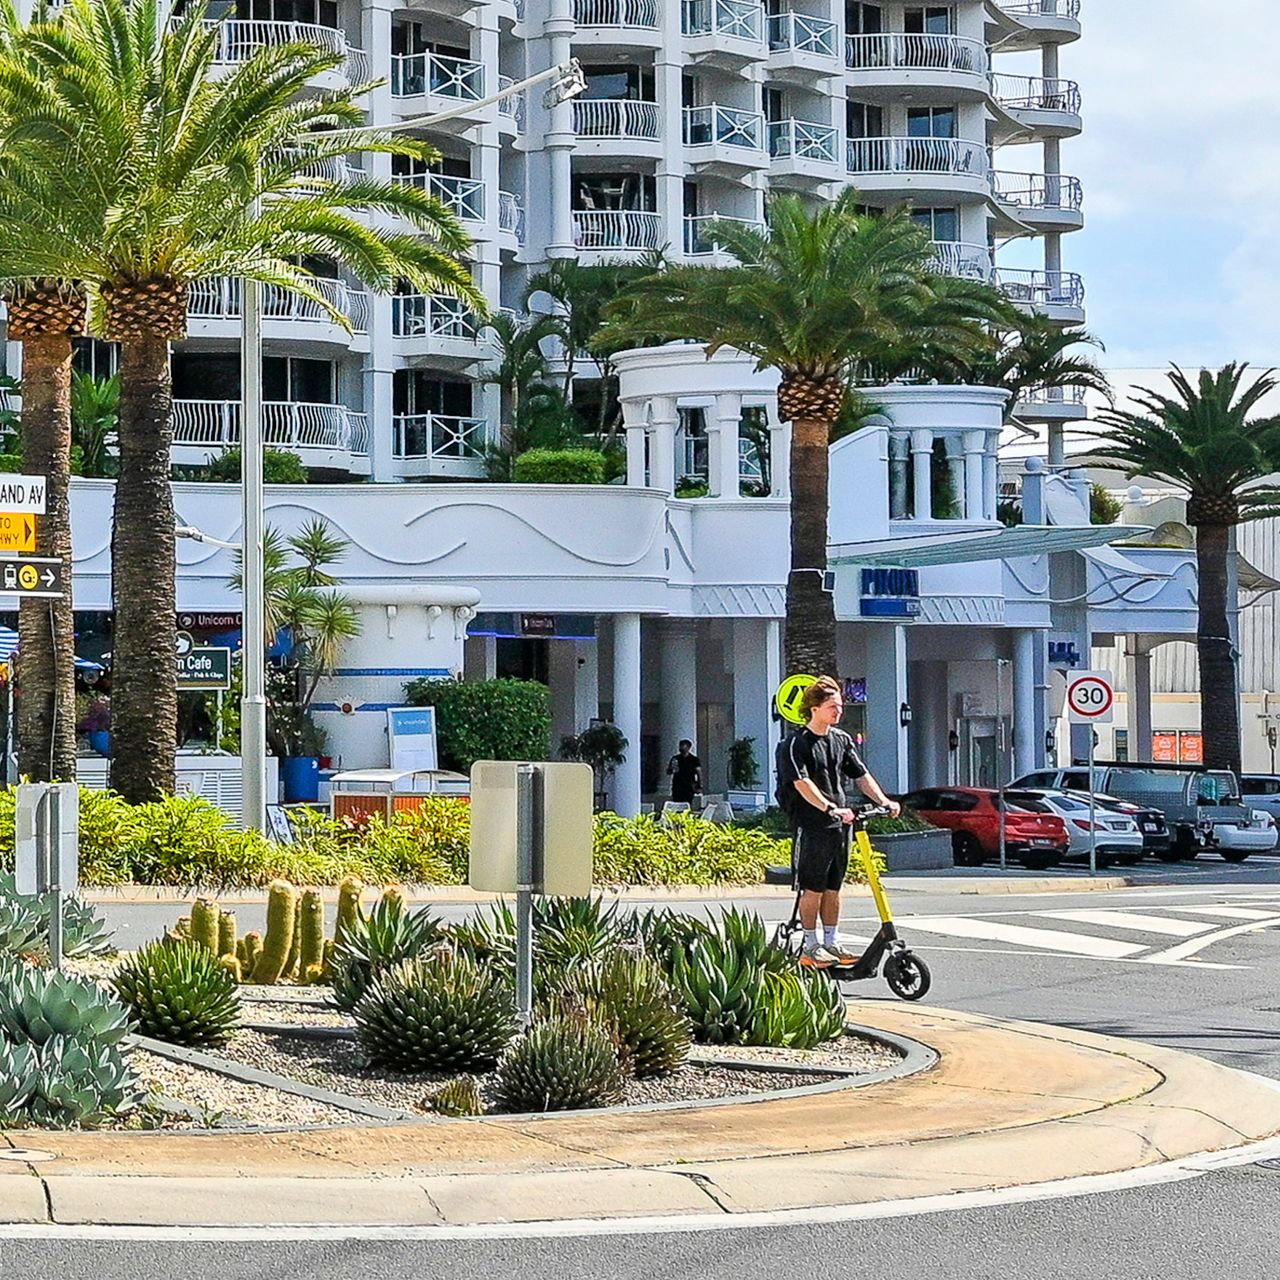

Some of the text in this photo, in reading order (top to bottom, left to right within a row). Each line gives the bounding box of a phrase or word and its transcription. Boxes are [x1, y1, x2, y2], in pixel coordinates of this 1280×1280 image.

[28, 485, 44, 505] AV
[0, 517, 12, 529] TO
[198, 614, 234, 626] Unicorn
[187, 656, 212, 670] Cafe
[1077, 687, 1103, 704] 30
